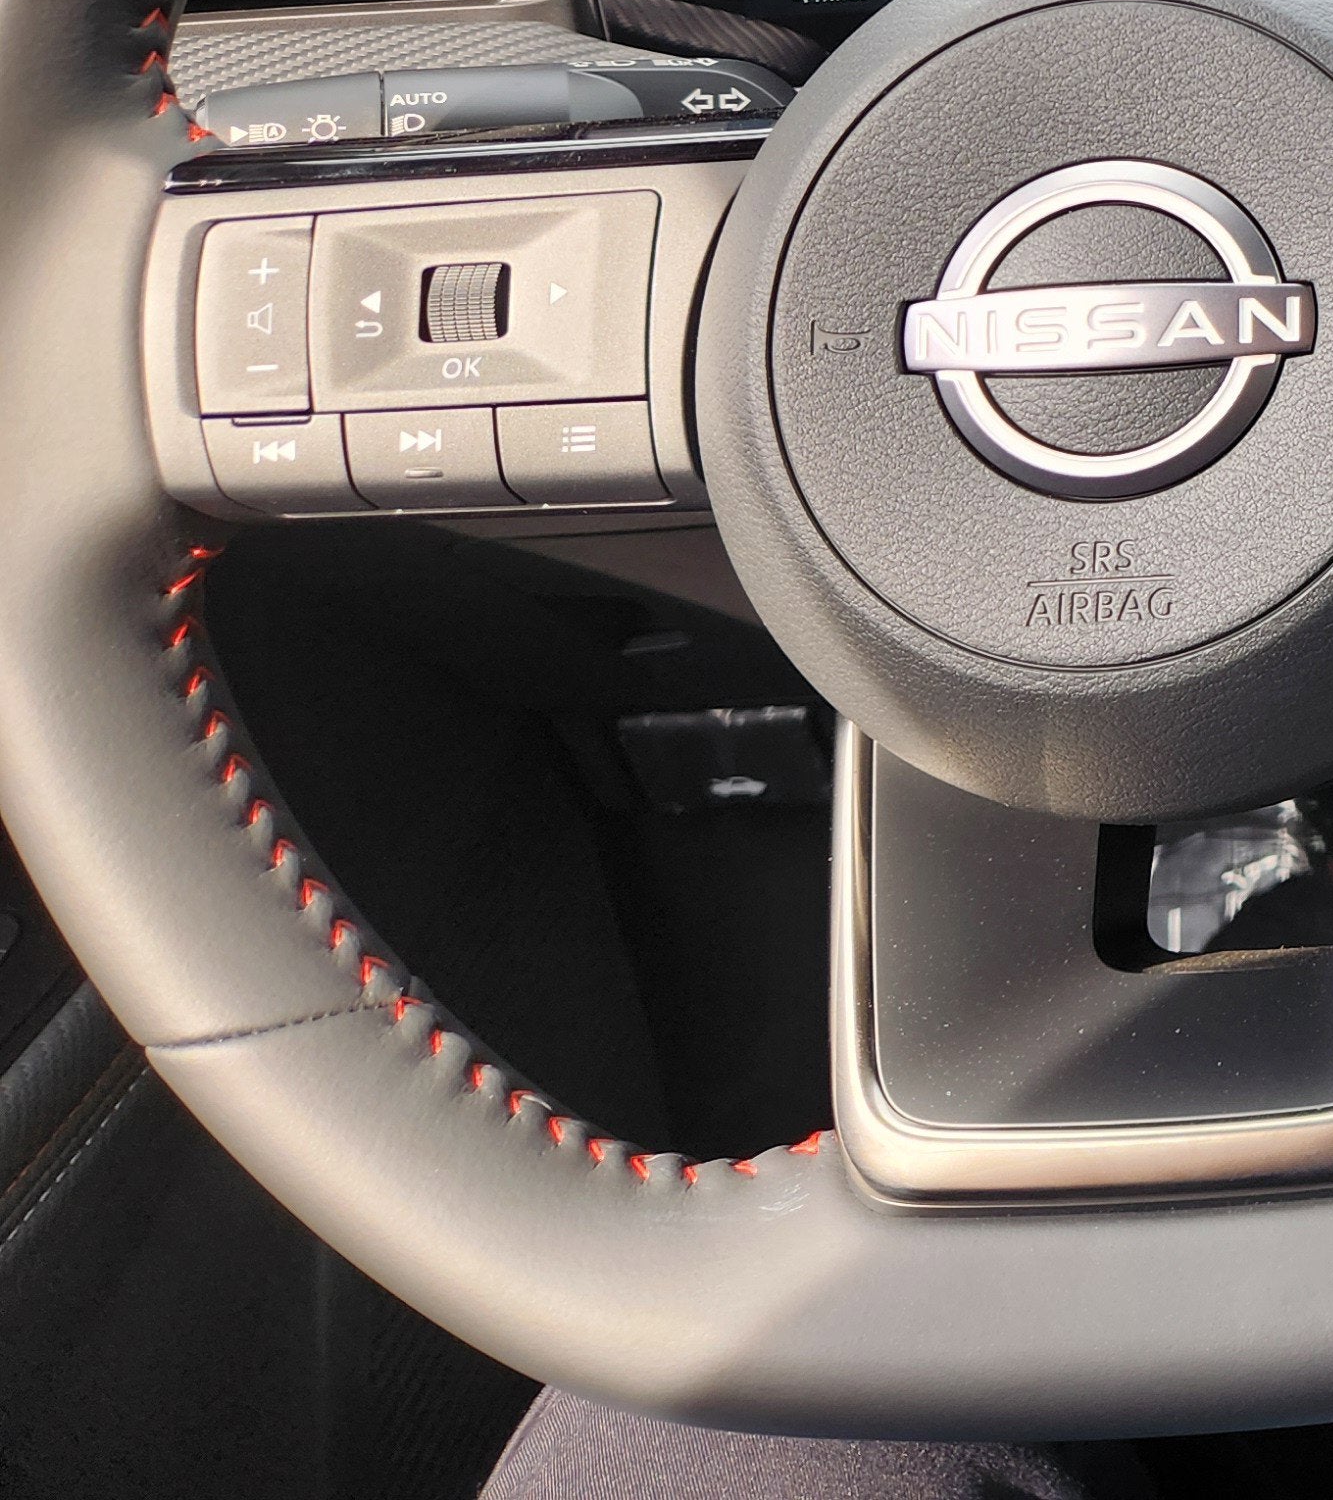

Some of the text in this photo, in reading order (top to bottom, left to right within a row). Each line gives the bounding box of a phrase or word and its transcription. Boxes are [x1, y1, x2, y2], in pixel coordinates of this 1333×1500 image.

[390, 91, 448, 107] AUTO
[913, 294, 1301, 362] NISSAN
[441, 356, 483, 380] OK
[1070, 538, 1136, 575] SRS
[1025, 585, 1177, 628] AIRBAG
